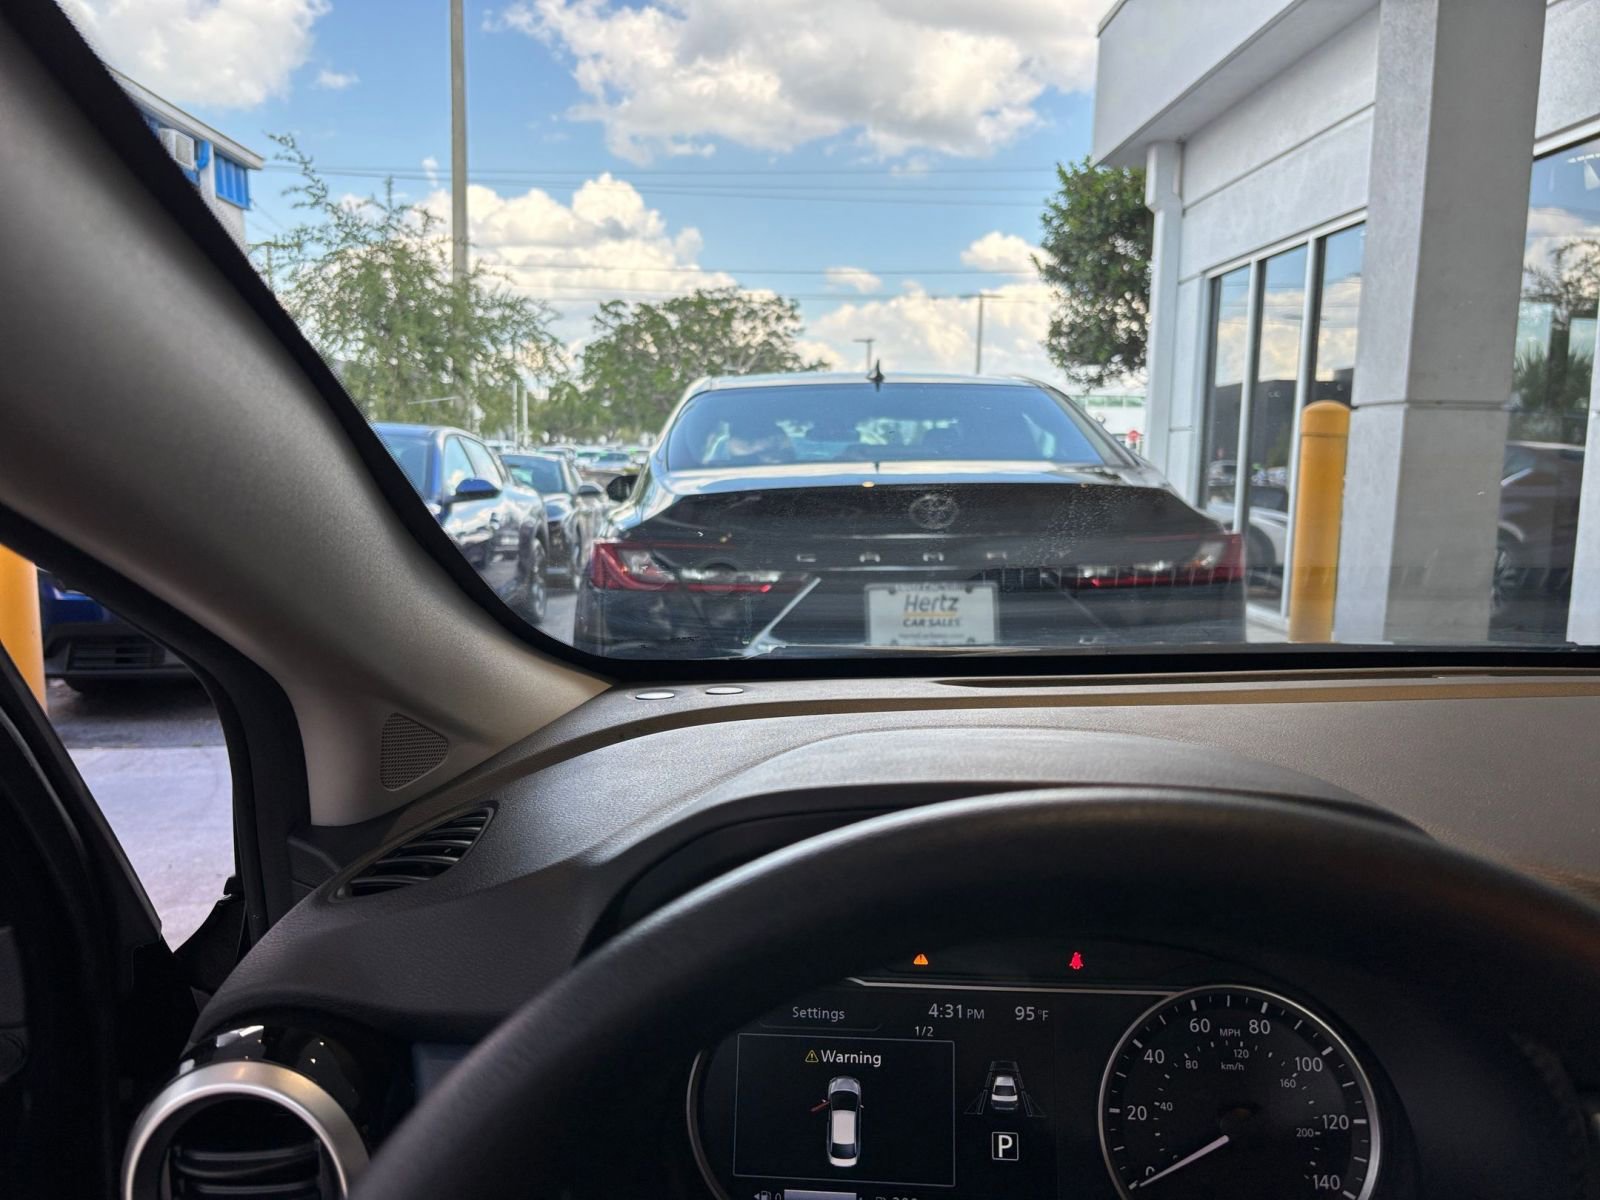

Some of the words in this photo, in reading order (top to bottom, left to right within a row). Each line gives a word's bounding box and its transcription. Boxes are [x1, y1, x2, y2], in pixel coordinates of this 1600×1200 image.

[903, 593, 960, 613] Hertz
[903, 618, 925, 628] CAR
[928, 618, 962, 628] SALES
[792, 1006, 846, 1023] Settings
[928, 1003, 964, 1019] 4:31
[966, 1008, 985, 1020] PM
[1015, 1006, 1035, 1021] 95
[914, 1025, 934, 1037] 1/2
[1189, 1017, 1211, 1033] 60
[1219, 1028, 1241, 1037] MPH
[1248, 1019, 1271, 1034] 80
[820, 1049, 882, 1068] Warning
[1143, 1048, 1165, 1064] 40
[1233, 1049, 1249, 1059] 120
[1185, 1059, 1199, 1070] 80
[1220, 1061, 1245, 1072] km/h
[1294, 1056, 1323, 1072] 100
[1279, 1078, 1297, 1089] 160
[1127, 1104, 1148, 1121] 20
[1160, 1101, 1173, 1112] 40
[1321, 1114, 1350, 1130] 120
[1296, 1127, 1314, 1138] 200
[997, 1134, 1013, 1158] P
[1312, 1174, 1341, 1190] 140
